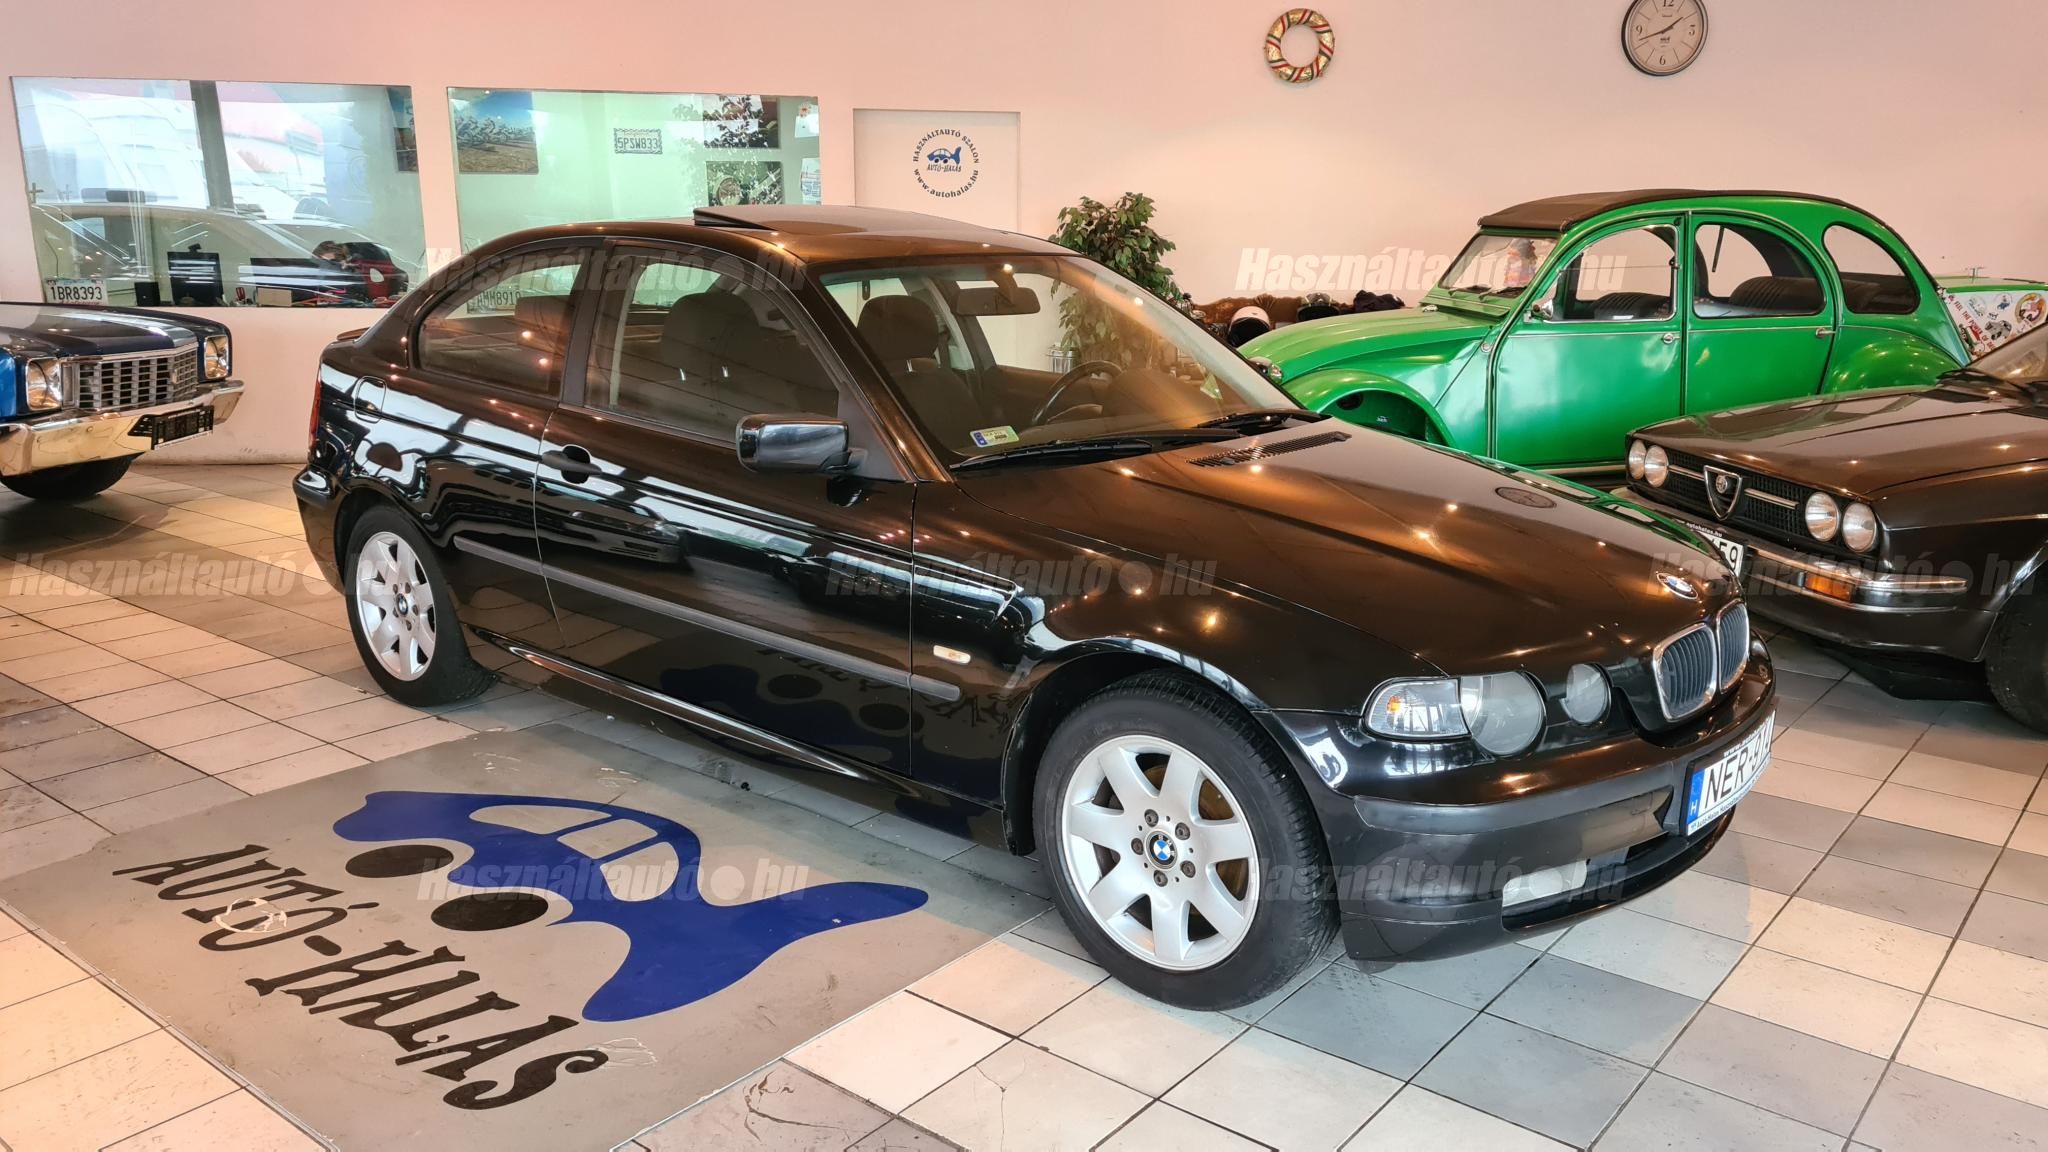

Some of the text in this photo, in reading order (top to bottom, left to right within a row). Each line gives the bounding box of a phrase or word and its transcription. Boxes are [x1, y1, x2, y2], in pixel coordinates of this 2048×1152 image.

[1659, 55, 1666, 65] 6
[961, 135, 980, 163] SZALON
[51, 286, 102, 300] 1BR8393
[1690, 801, 1698, 816] H
[112, 844, 609, 1110] AUTÓ-HALAS
